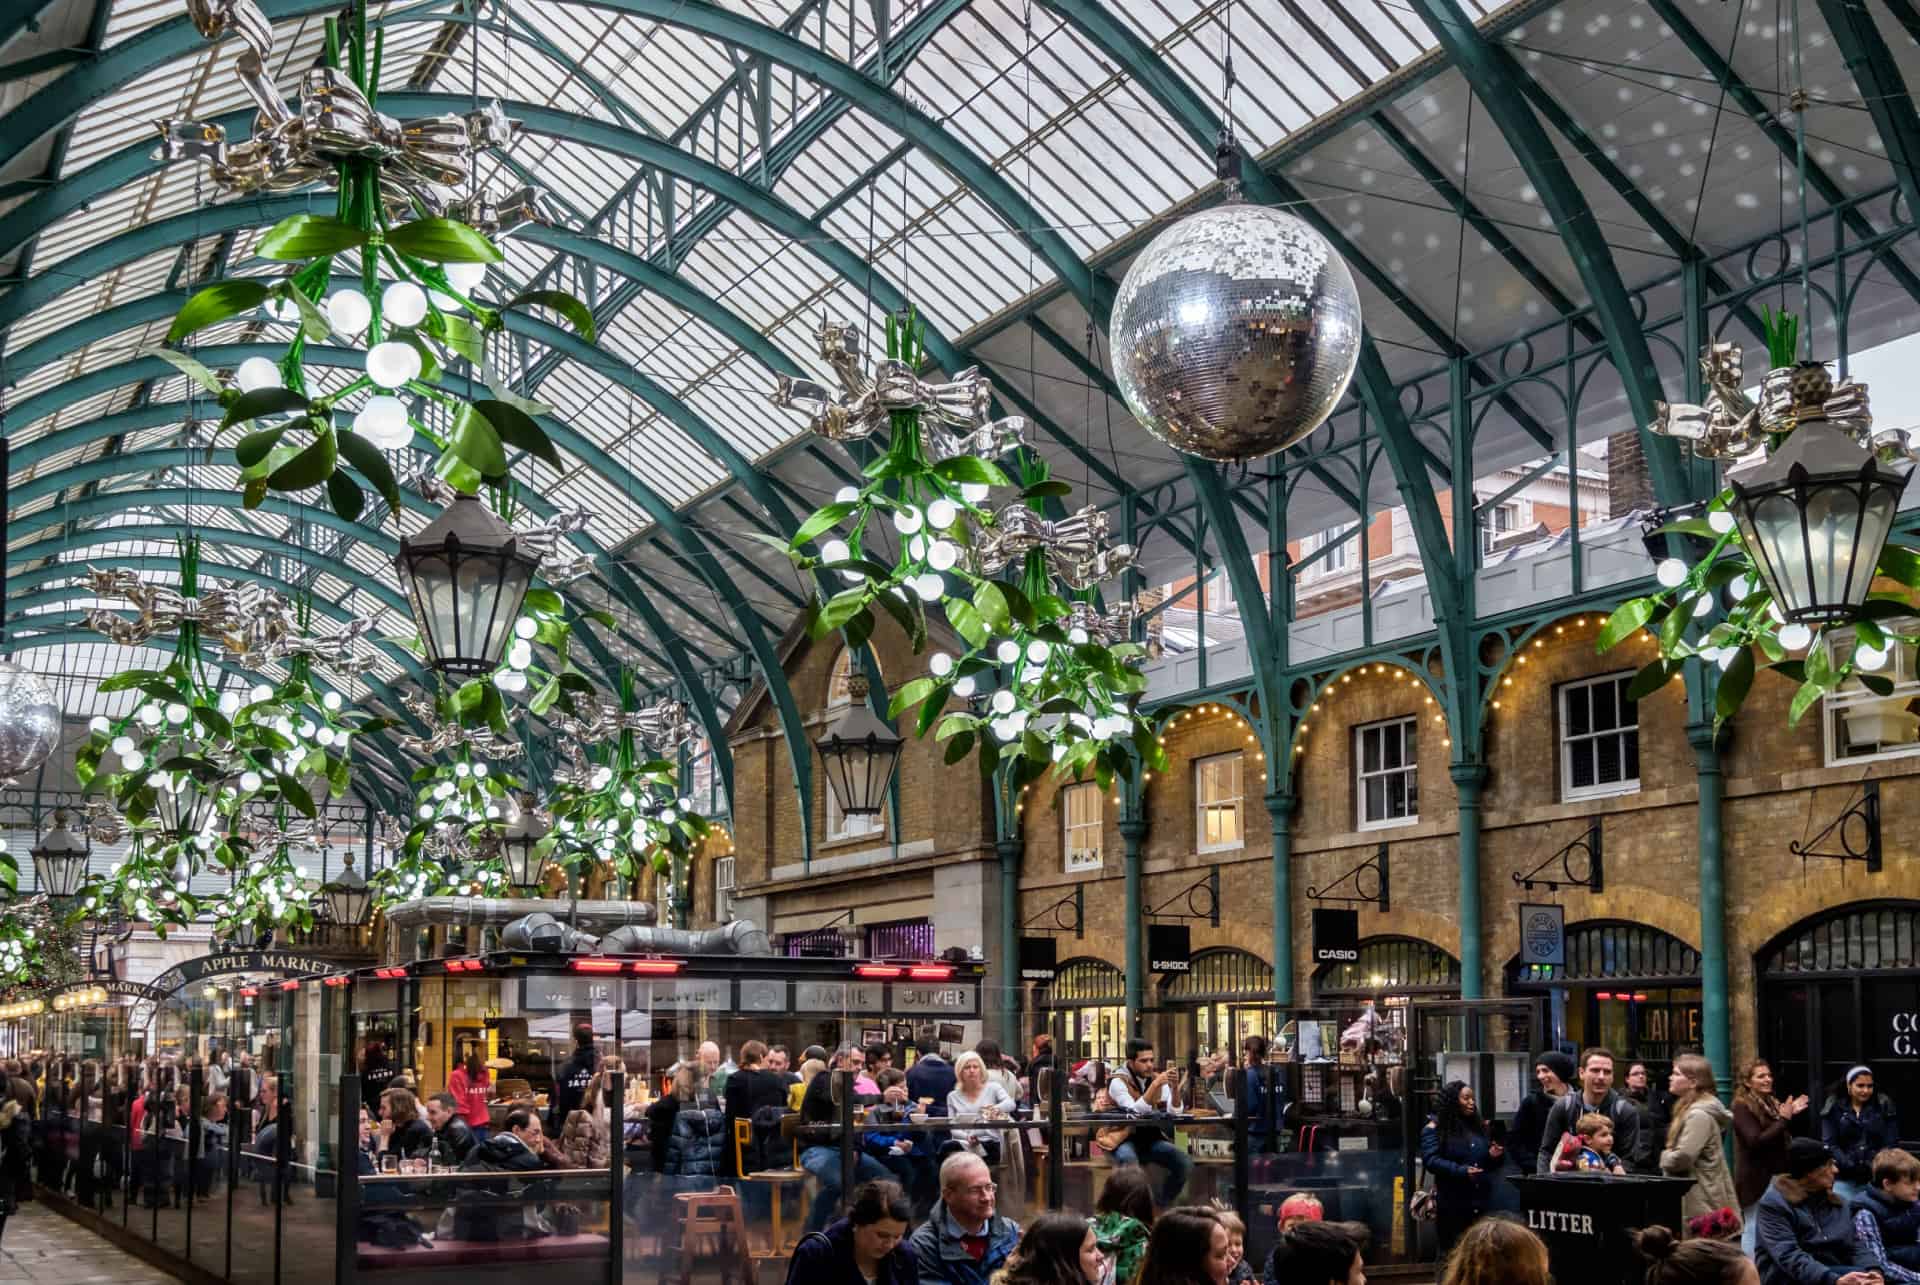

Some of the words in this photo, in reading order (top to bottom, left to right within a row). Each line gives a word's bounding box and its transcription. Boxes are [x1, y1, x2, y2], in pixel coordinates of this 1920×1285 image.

[1318, 949, 1357, 960] CASIO
[201, 955, 249, 974] APPLE
[261, 955, 333, 974] MARKET
[1152, 960, 1189, 970] G-SHOCK
[1528, 1209, 1594, 1235] LITTER
